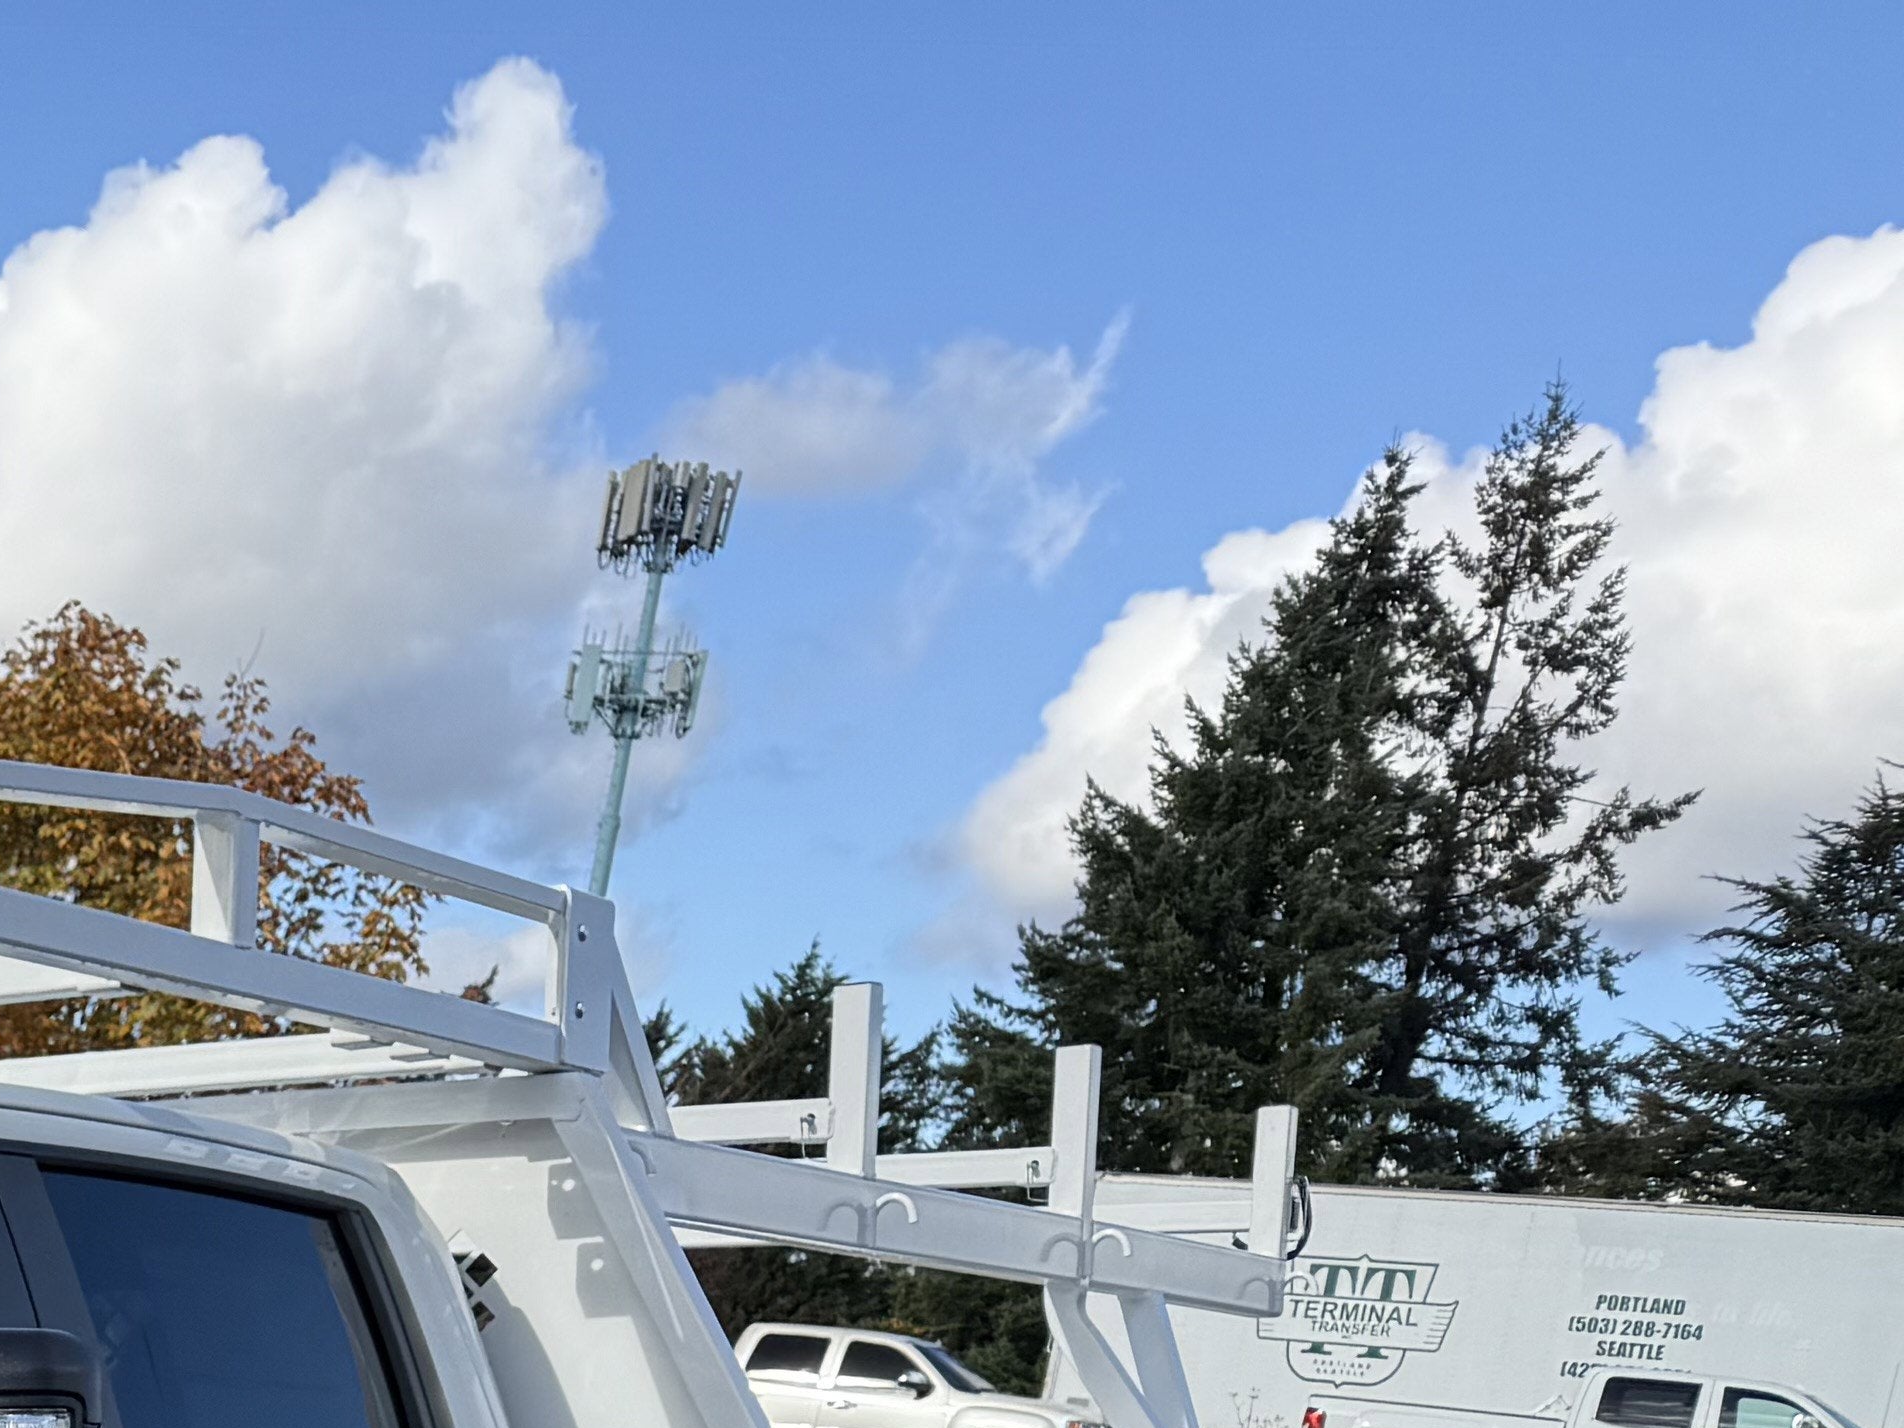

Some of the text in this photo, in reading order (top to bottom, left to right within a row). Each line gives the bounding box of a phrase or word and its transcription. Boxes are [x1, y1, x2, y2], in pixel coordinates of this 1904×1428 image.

[1289, 1299, 1418, 1327] TERMINAL
[1595, 1294, 1686, 1316] PORTLAND
[1311, 1320, 1392, 1337] TRANSFER
[1567, 1316, 1704, 1341] (503) 288-7164
[1595, 1340, 1666, 1361] SEATTLE
